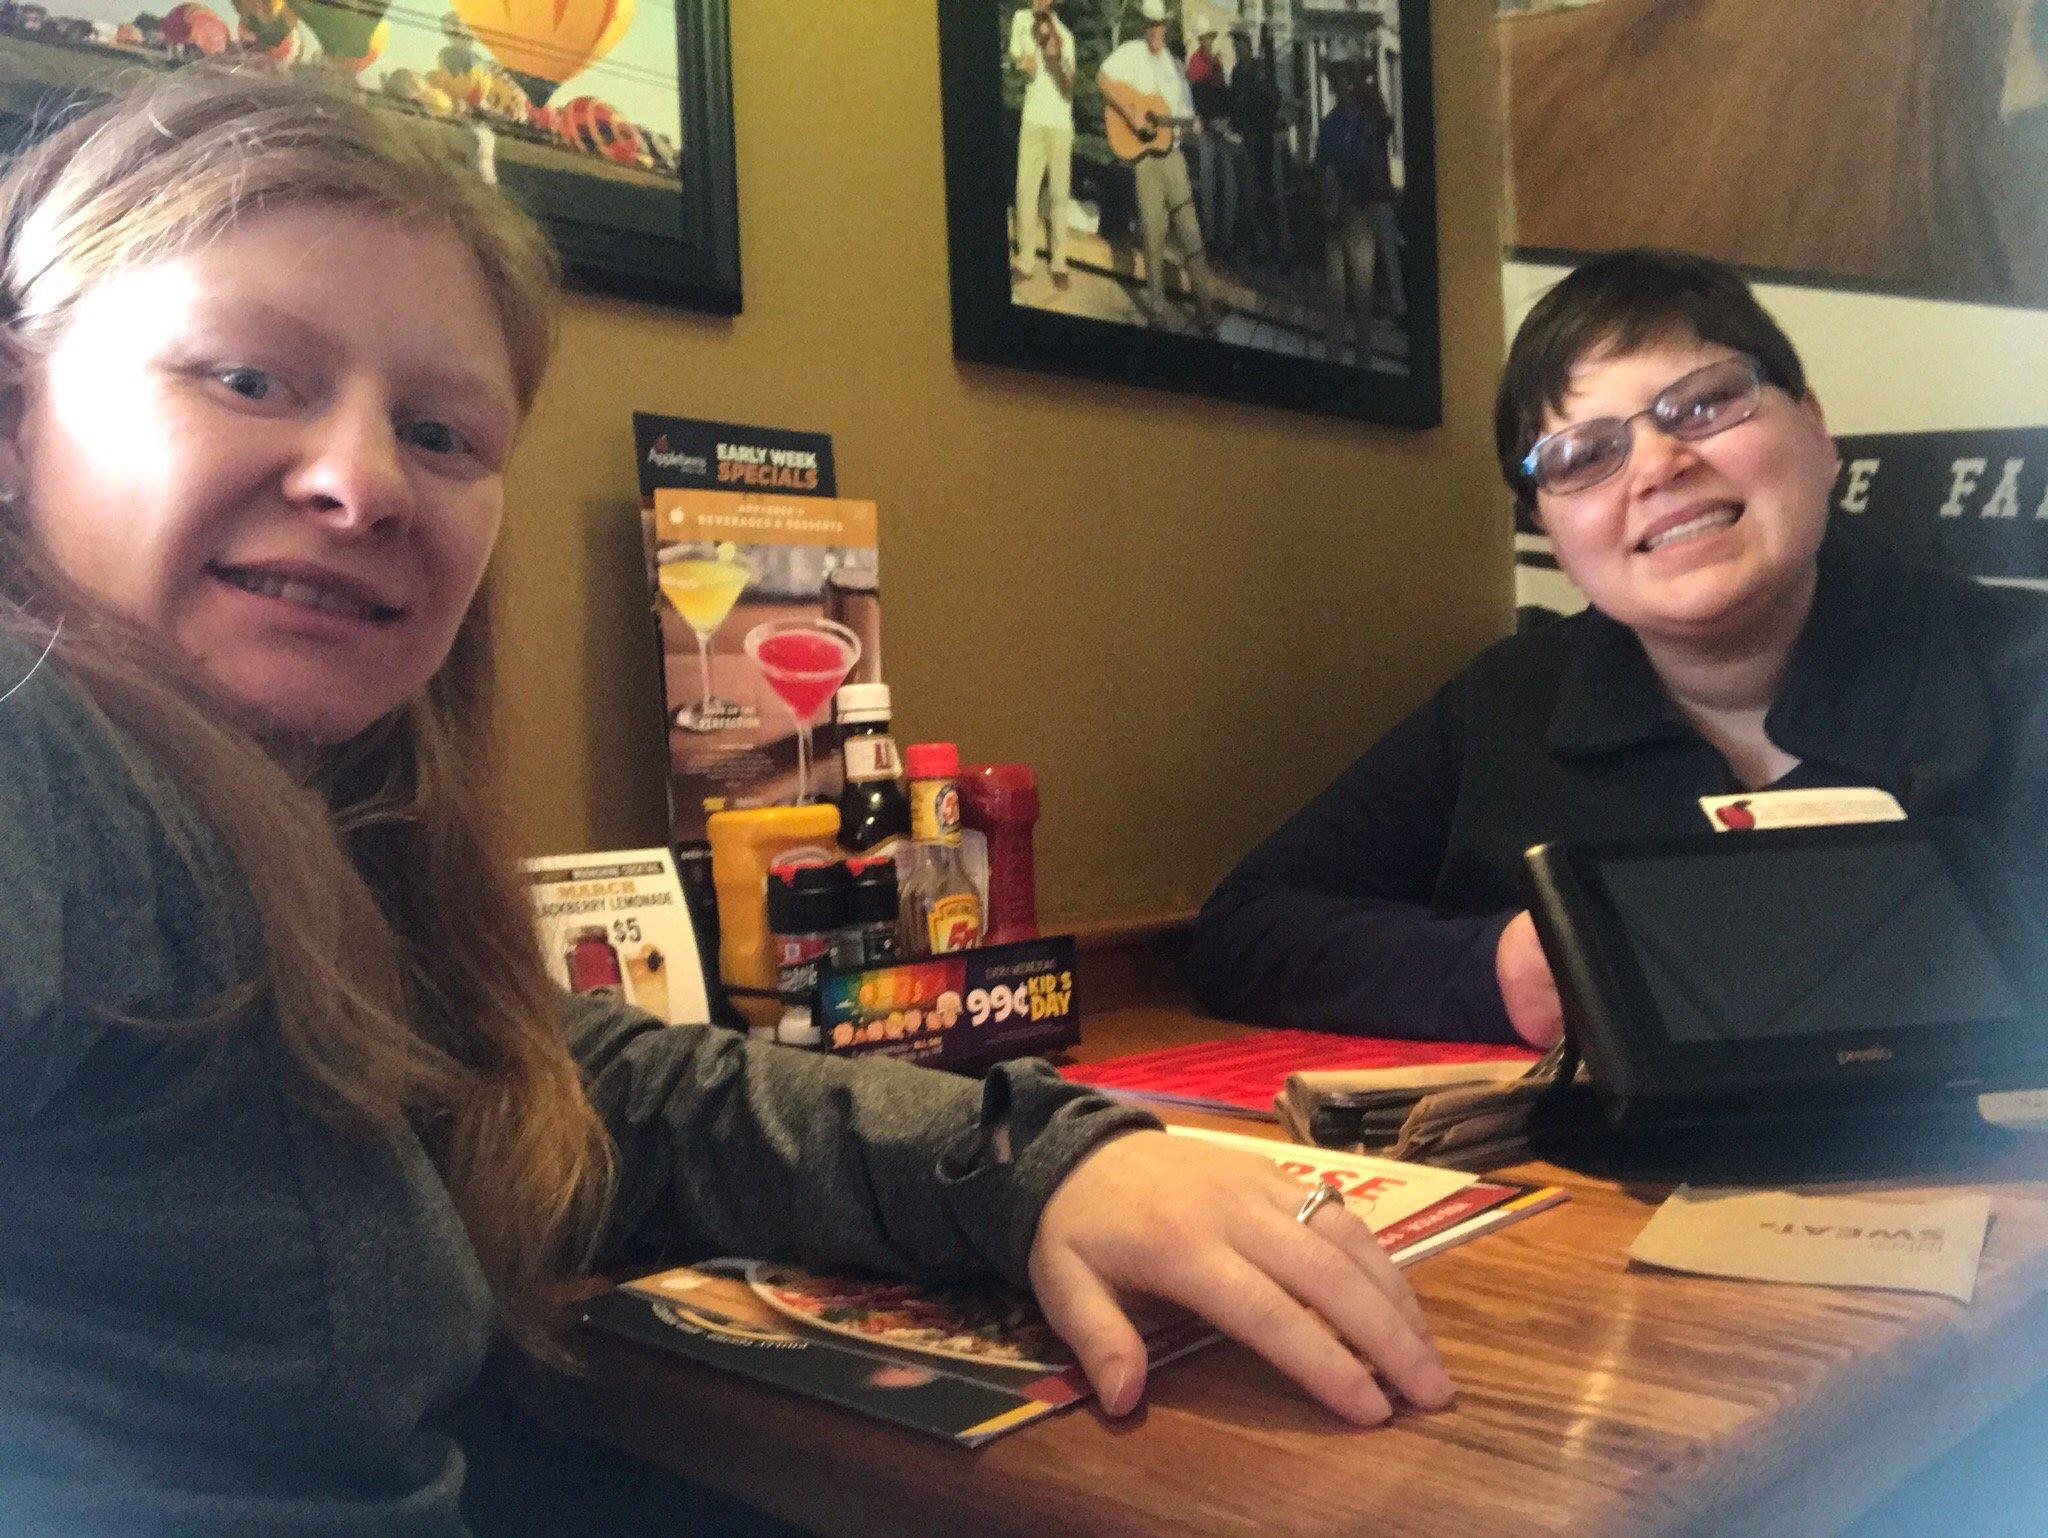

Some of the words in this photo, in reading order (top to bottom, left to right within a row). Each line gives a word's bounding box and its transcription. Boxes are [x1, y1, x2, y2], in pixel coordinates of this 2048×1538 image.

[716, 442, 767, 464] EARLY
[769, 448, 817, 469] WEEK
[717, 460, 819, 490] SPECIALS
[1838, 457, 1880, 514] E
[612, 916, 643, 943] $5
[965, 980, 1030, 1028] 99¢
[1029, 988, 1072, 1022] DAY
